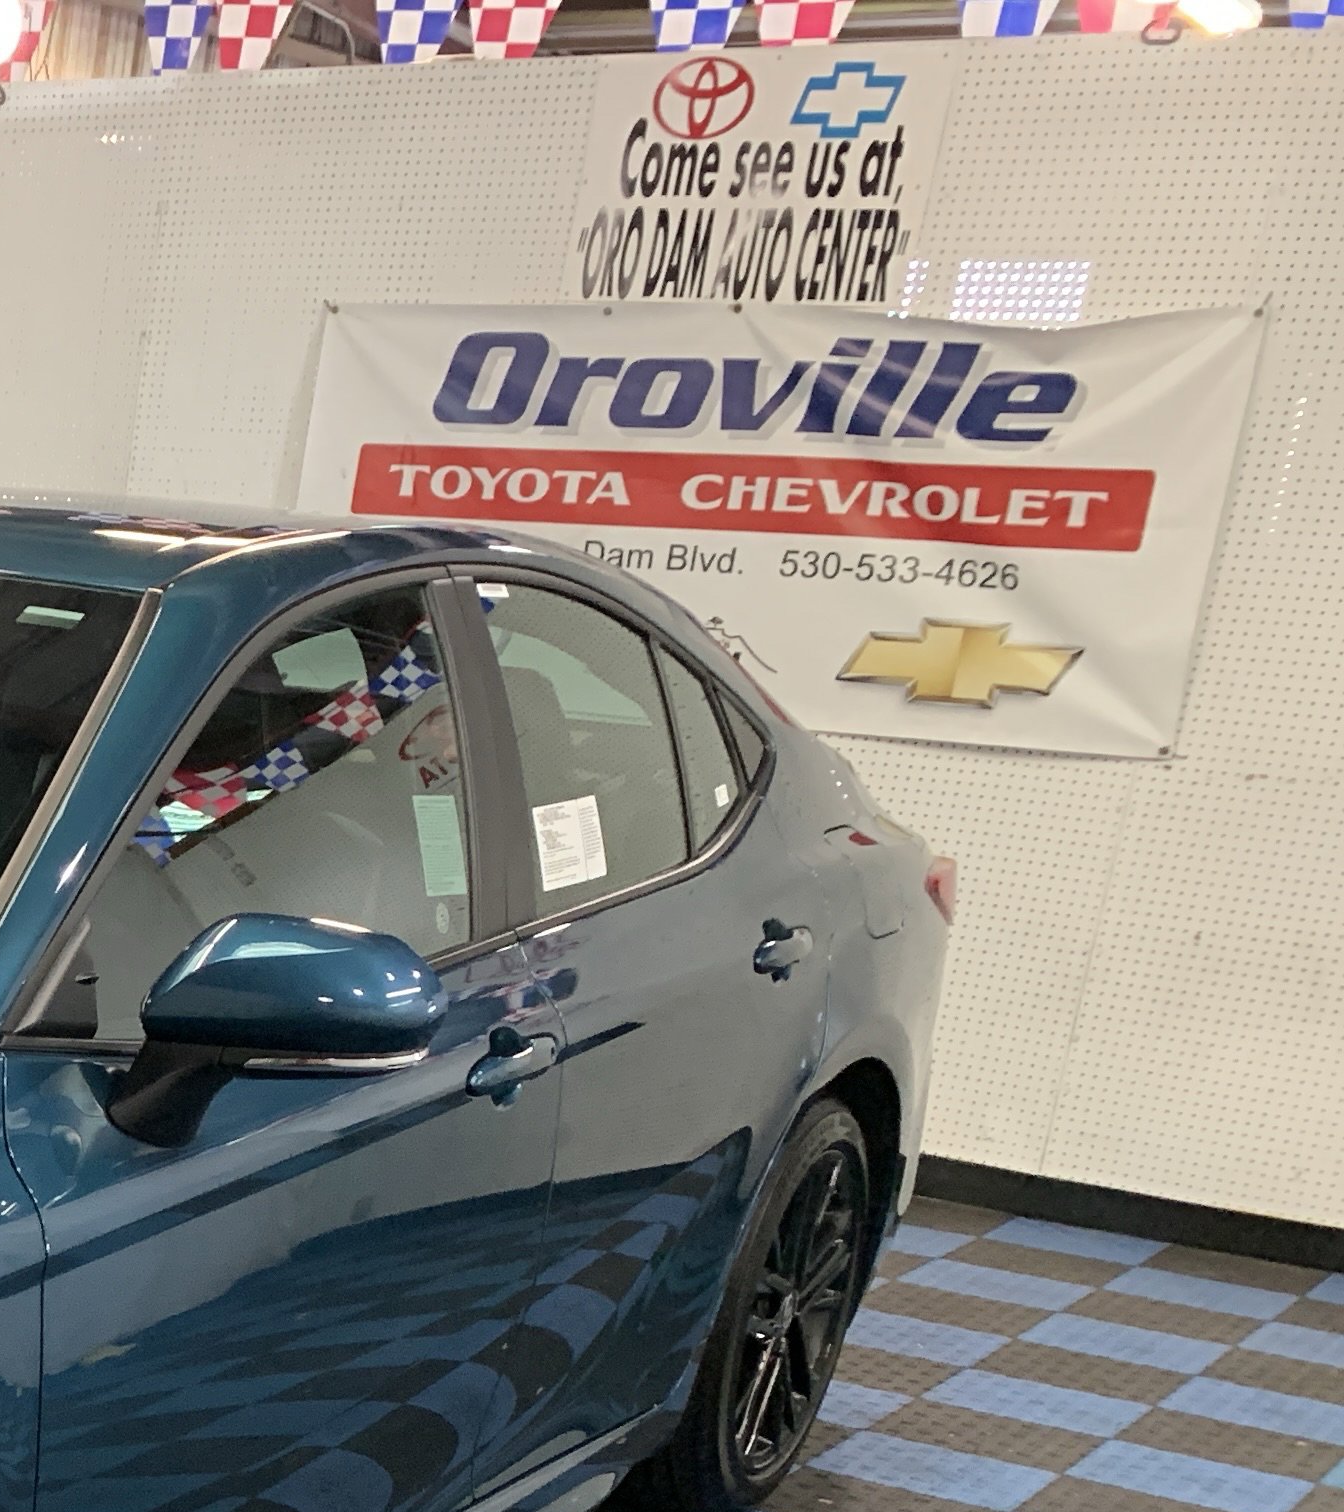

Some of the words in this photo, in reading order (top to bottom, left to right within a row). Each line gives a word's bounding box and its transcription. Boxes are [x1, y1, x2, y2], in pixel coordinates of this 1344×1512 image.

[620, 117, 720, 199] Come
[729, 140, 795, 199] see
[805, 139, 851, 199] us
[859, 125, 905, 204] at,
[642, 207, 717, 299] DAM
[714, 205, 794, 301] AUTO
[432, 330, 1078, 443] Oroville
[388, 462, 631, 508] TOYOTA
[680, 472, 1109, 530] CHEVROLET
[583, 540, 654, 569] Dam
[666, 544, 743, 575] Blvd.
[779, 549, 1020, 592] 530-533-4626
